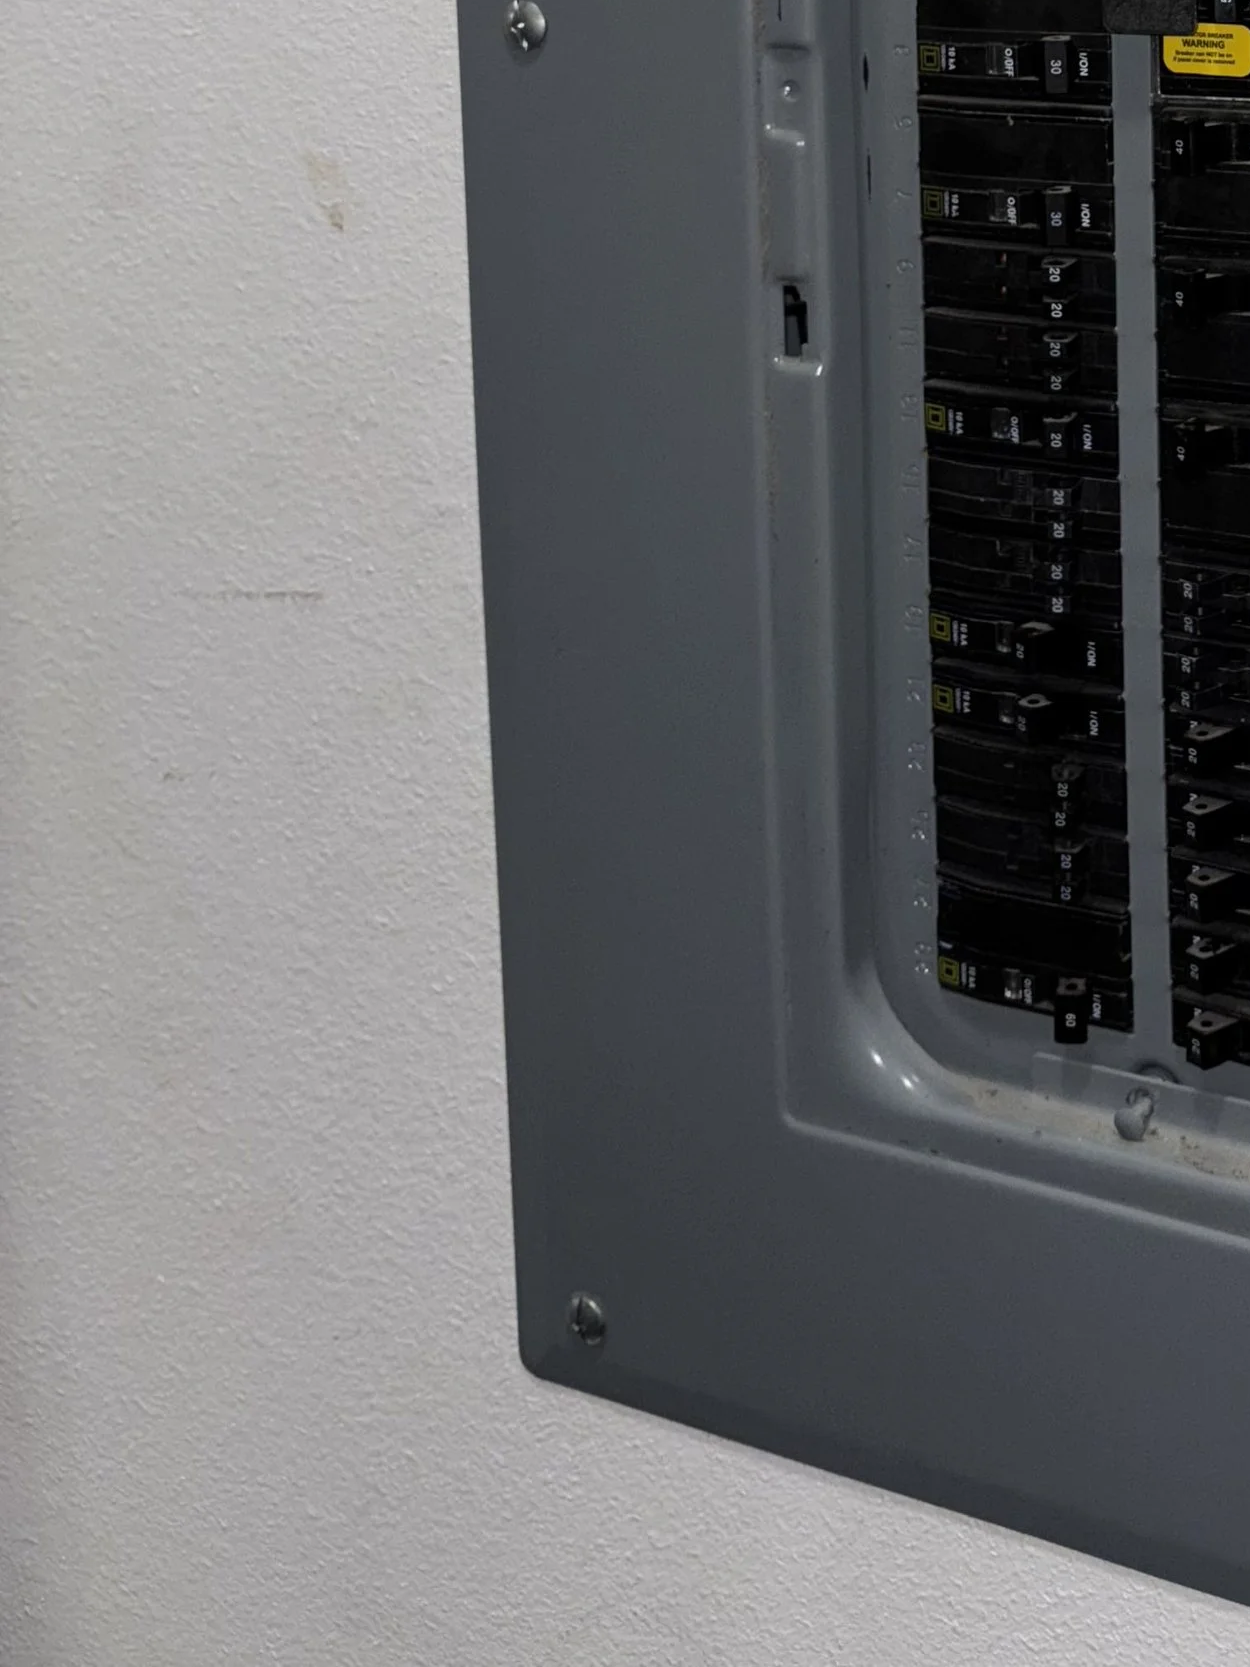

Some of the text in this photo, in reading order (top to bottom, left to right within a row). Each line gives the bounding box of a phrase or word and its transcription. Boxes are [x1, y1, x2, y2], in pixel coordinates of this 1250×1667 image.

[1182, 39, 1225, 49] WARNING
[1050, 59, 1061, 75] 30
[1175, 139, 1184, 155] 40
[1049, 267, 1061, 283] 20
[1051, 302, 1062, 319] 20
